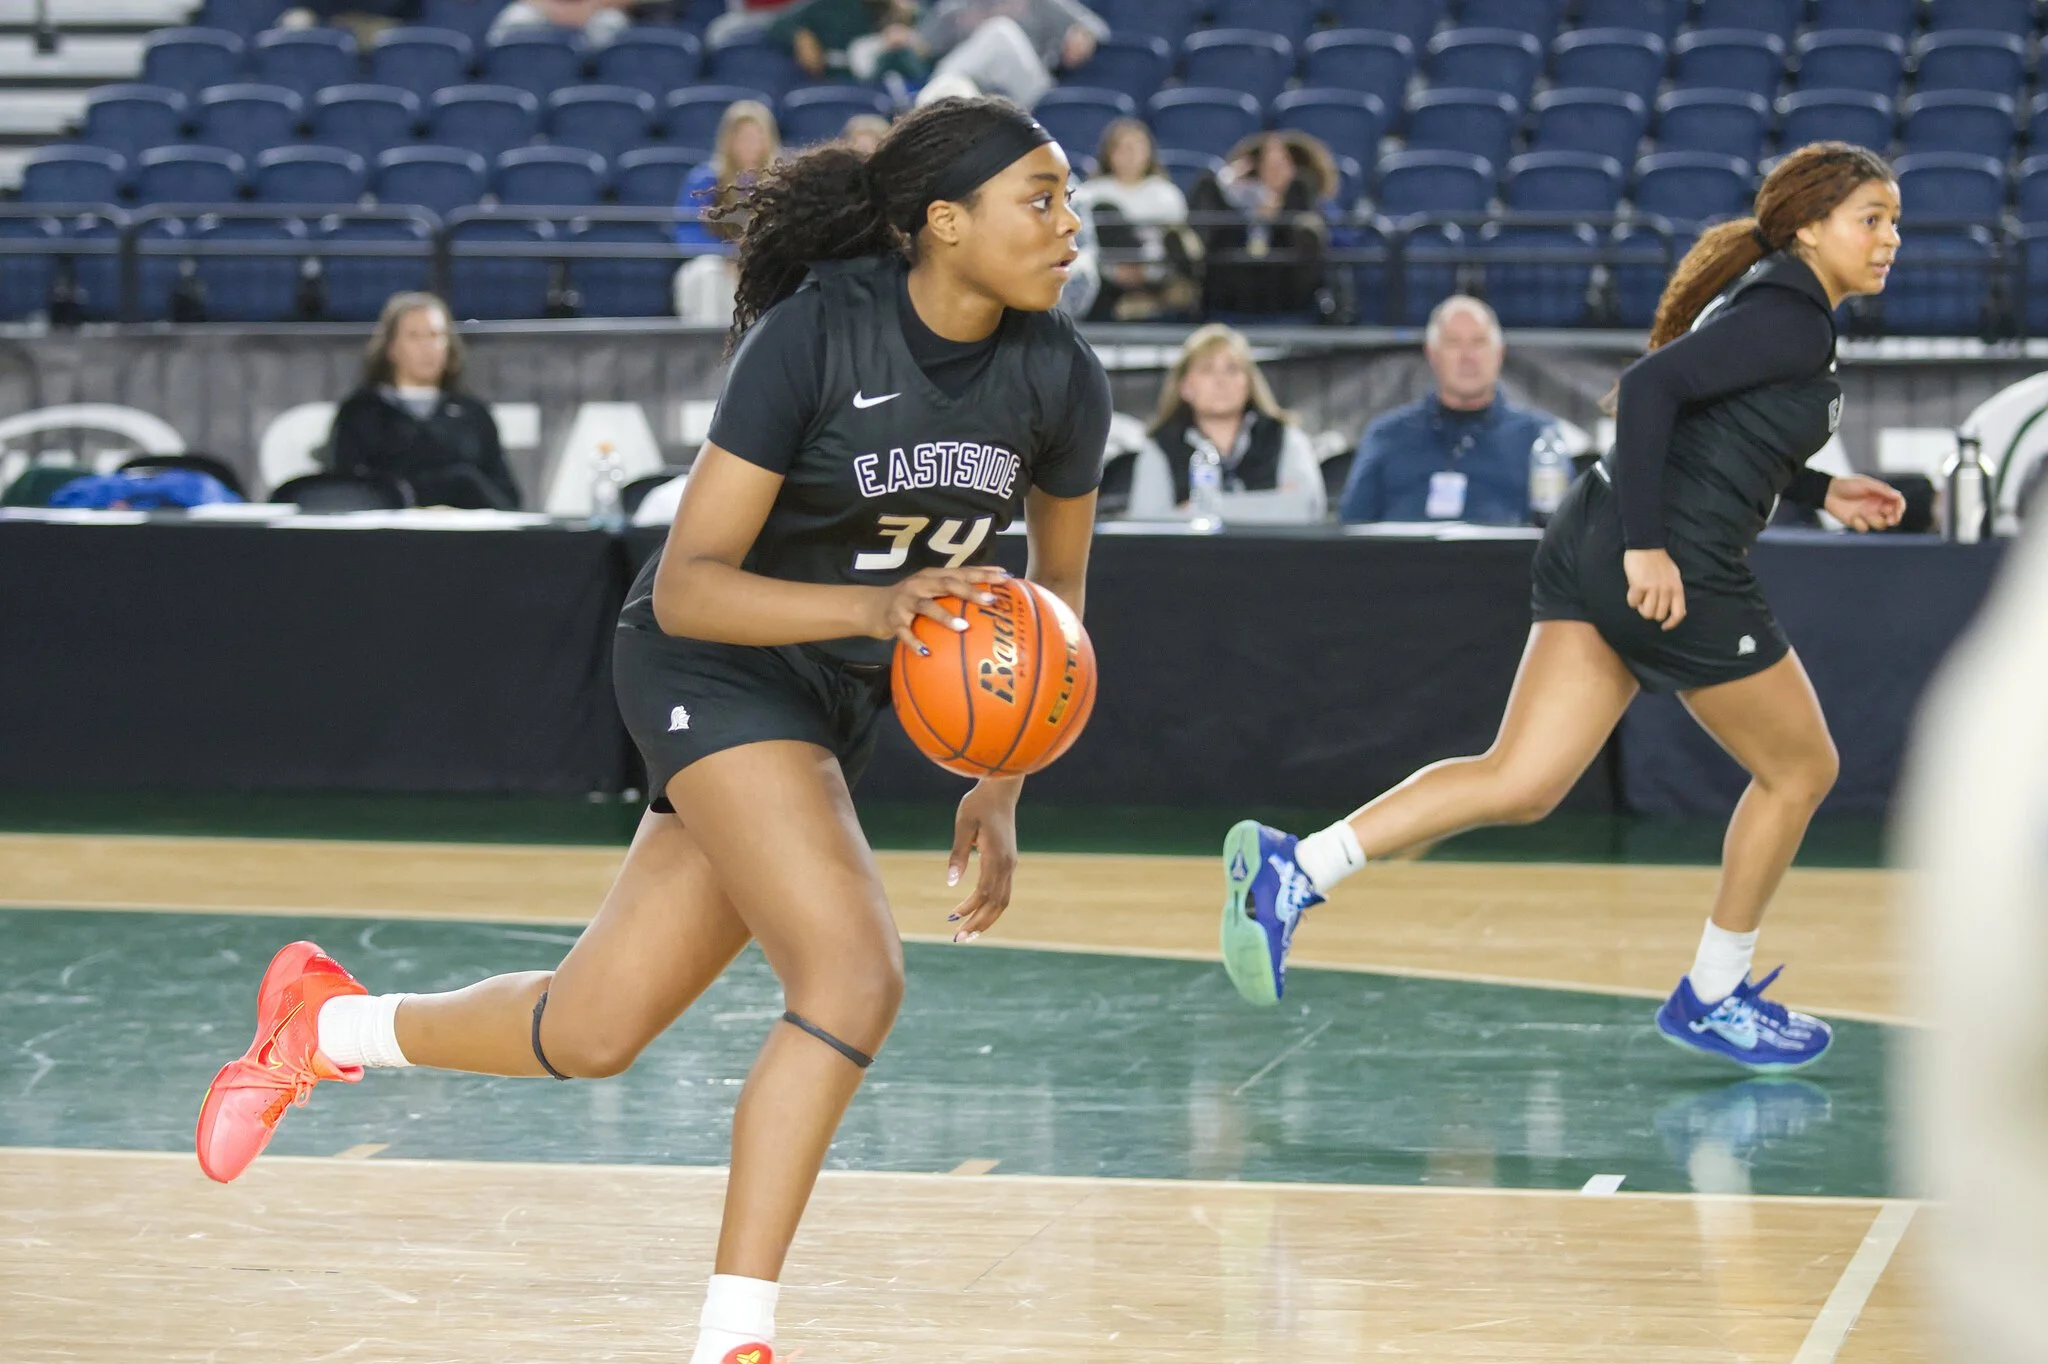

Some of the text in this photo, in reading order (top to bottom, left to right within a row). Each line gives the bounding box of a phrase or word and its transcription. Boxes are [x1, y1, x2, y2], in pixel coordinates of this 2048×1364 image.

[853, 441, 1021, 499] EASTSIDE
[853, 514, 995, 571] 34
[979, 584, 1018, 705] Baden
[1046, 632, 1078, 725] ELIT
